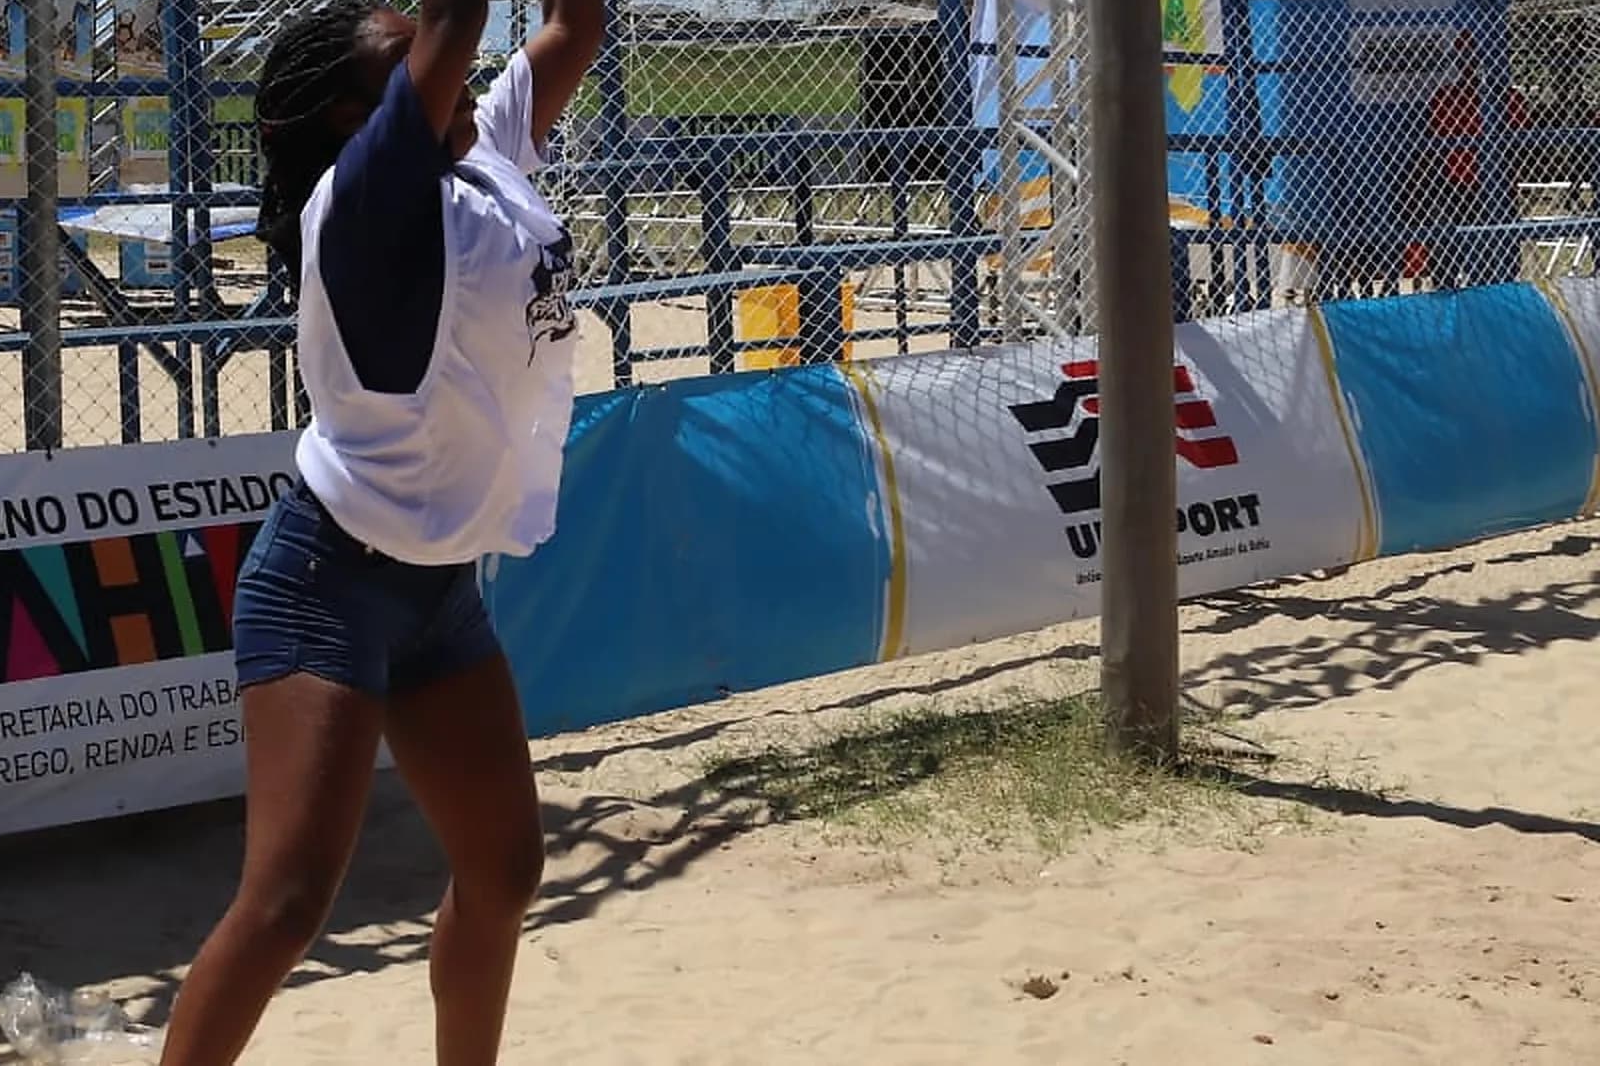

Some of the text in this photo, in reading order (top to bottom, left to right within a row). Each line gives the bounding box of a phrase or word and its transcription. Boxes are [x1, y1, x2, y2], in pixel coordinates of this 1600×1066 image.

[76, 488, 139, 530] DO
[120, 691, 157, 720] DO
[161, 679, 241, 713] TRAB
[85, 730, 175, 768] RENDA
[184, 725, 199, 751] E
[207, 719, 247, 747] ES
